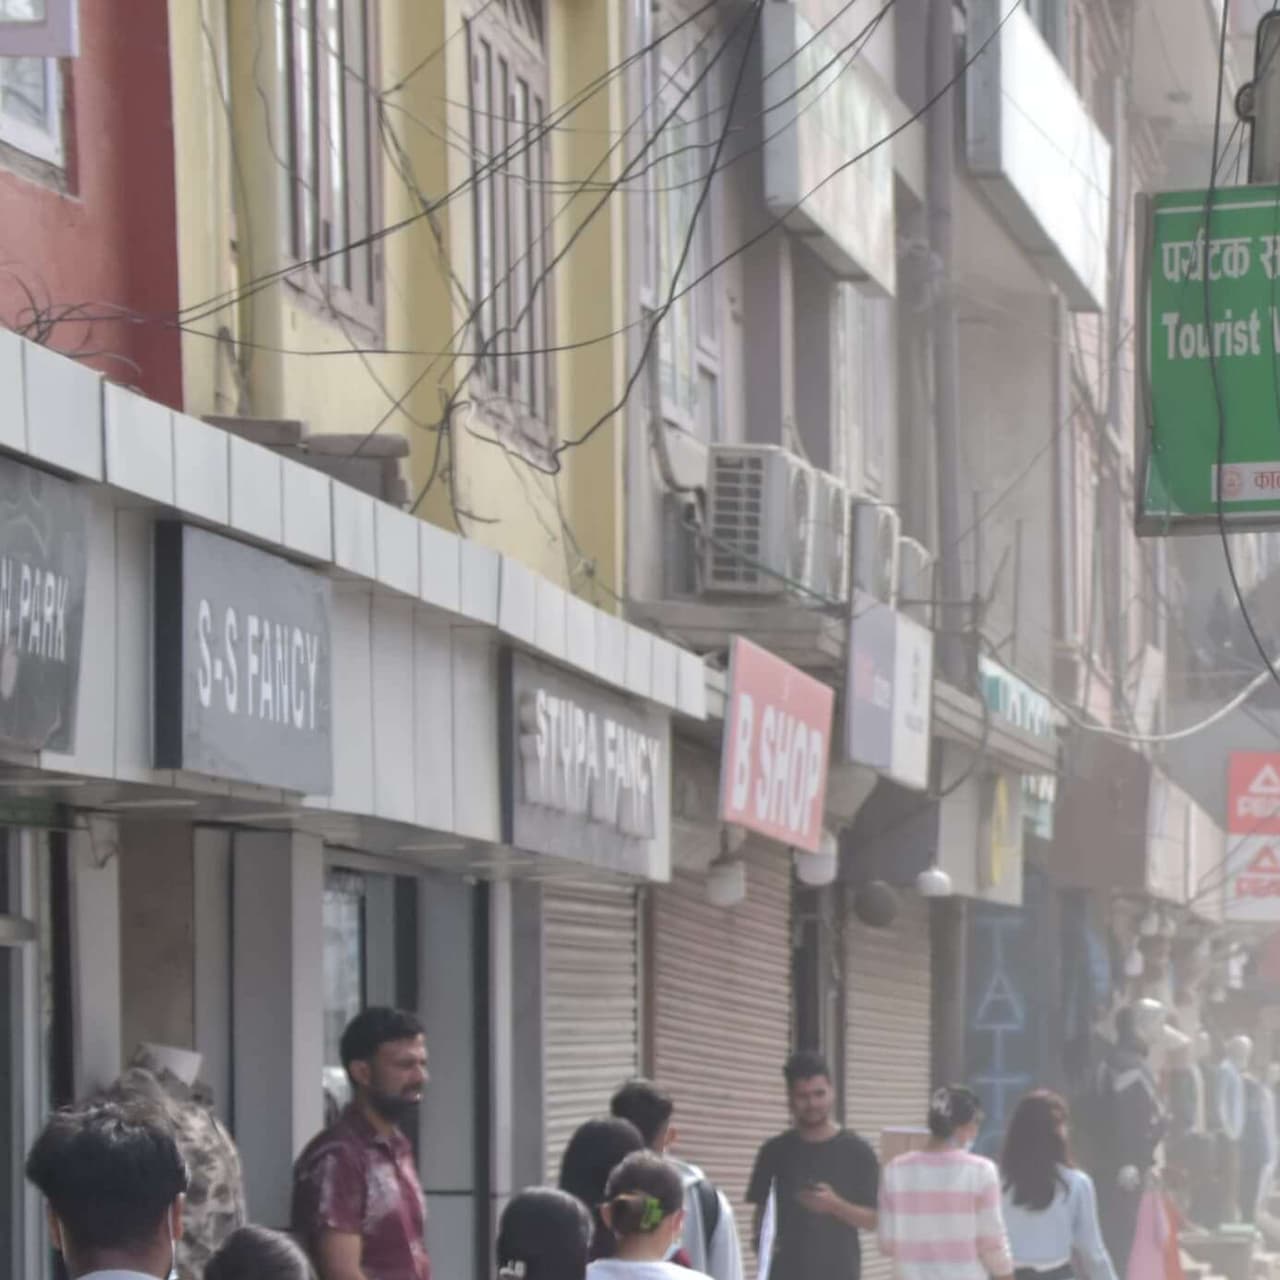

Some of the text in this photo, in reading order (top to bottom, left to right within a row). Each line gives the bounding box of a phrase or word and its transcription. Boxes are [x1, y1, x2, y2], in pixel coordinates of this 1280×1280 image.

[1161, 309, 1261, 360] Tourist
[17, 562, 69, 663] PARK
[198, 598, 319, 729] S-S FANCY
[604, 717, 661, 815] FANCY
[755, 704, 823, 837] SHOP
